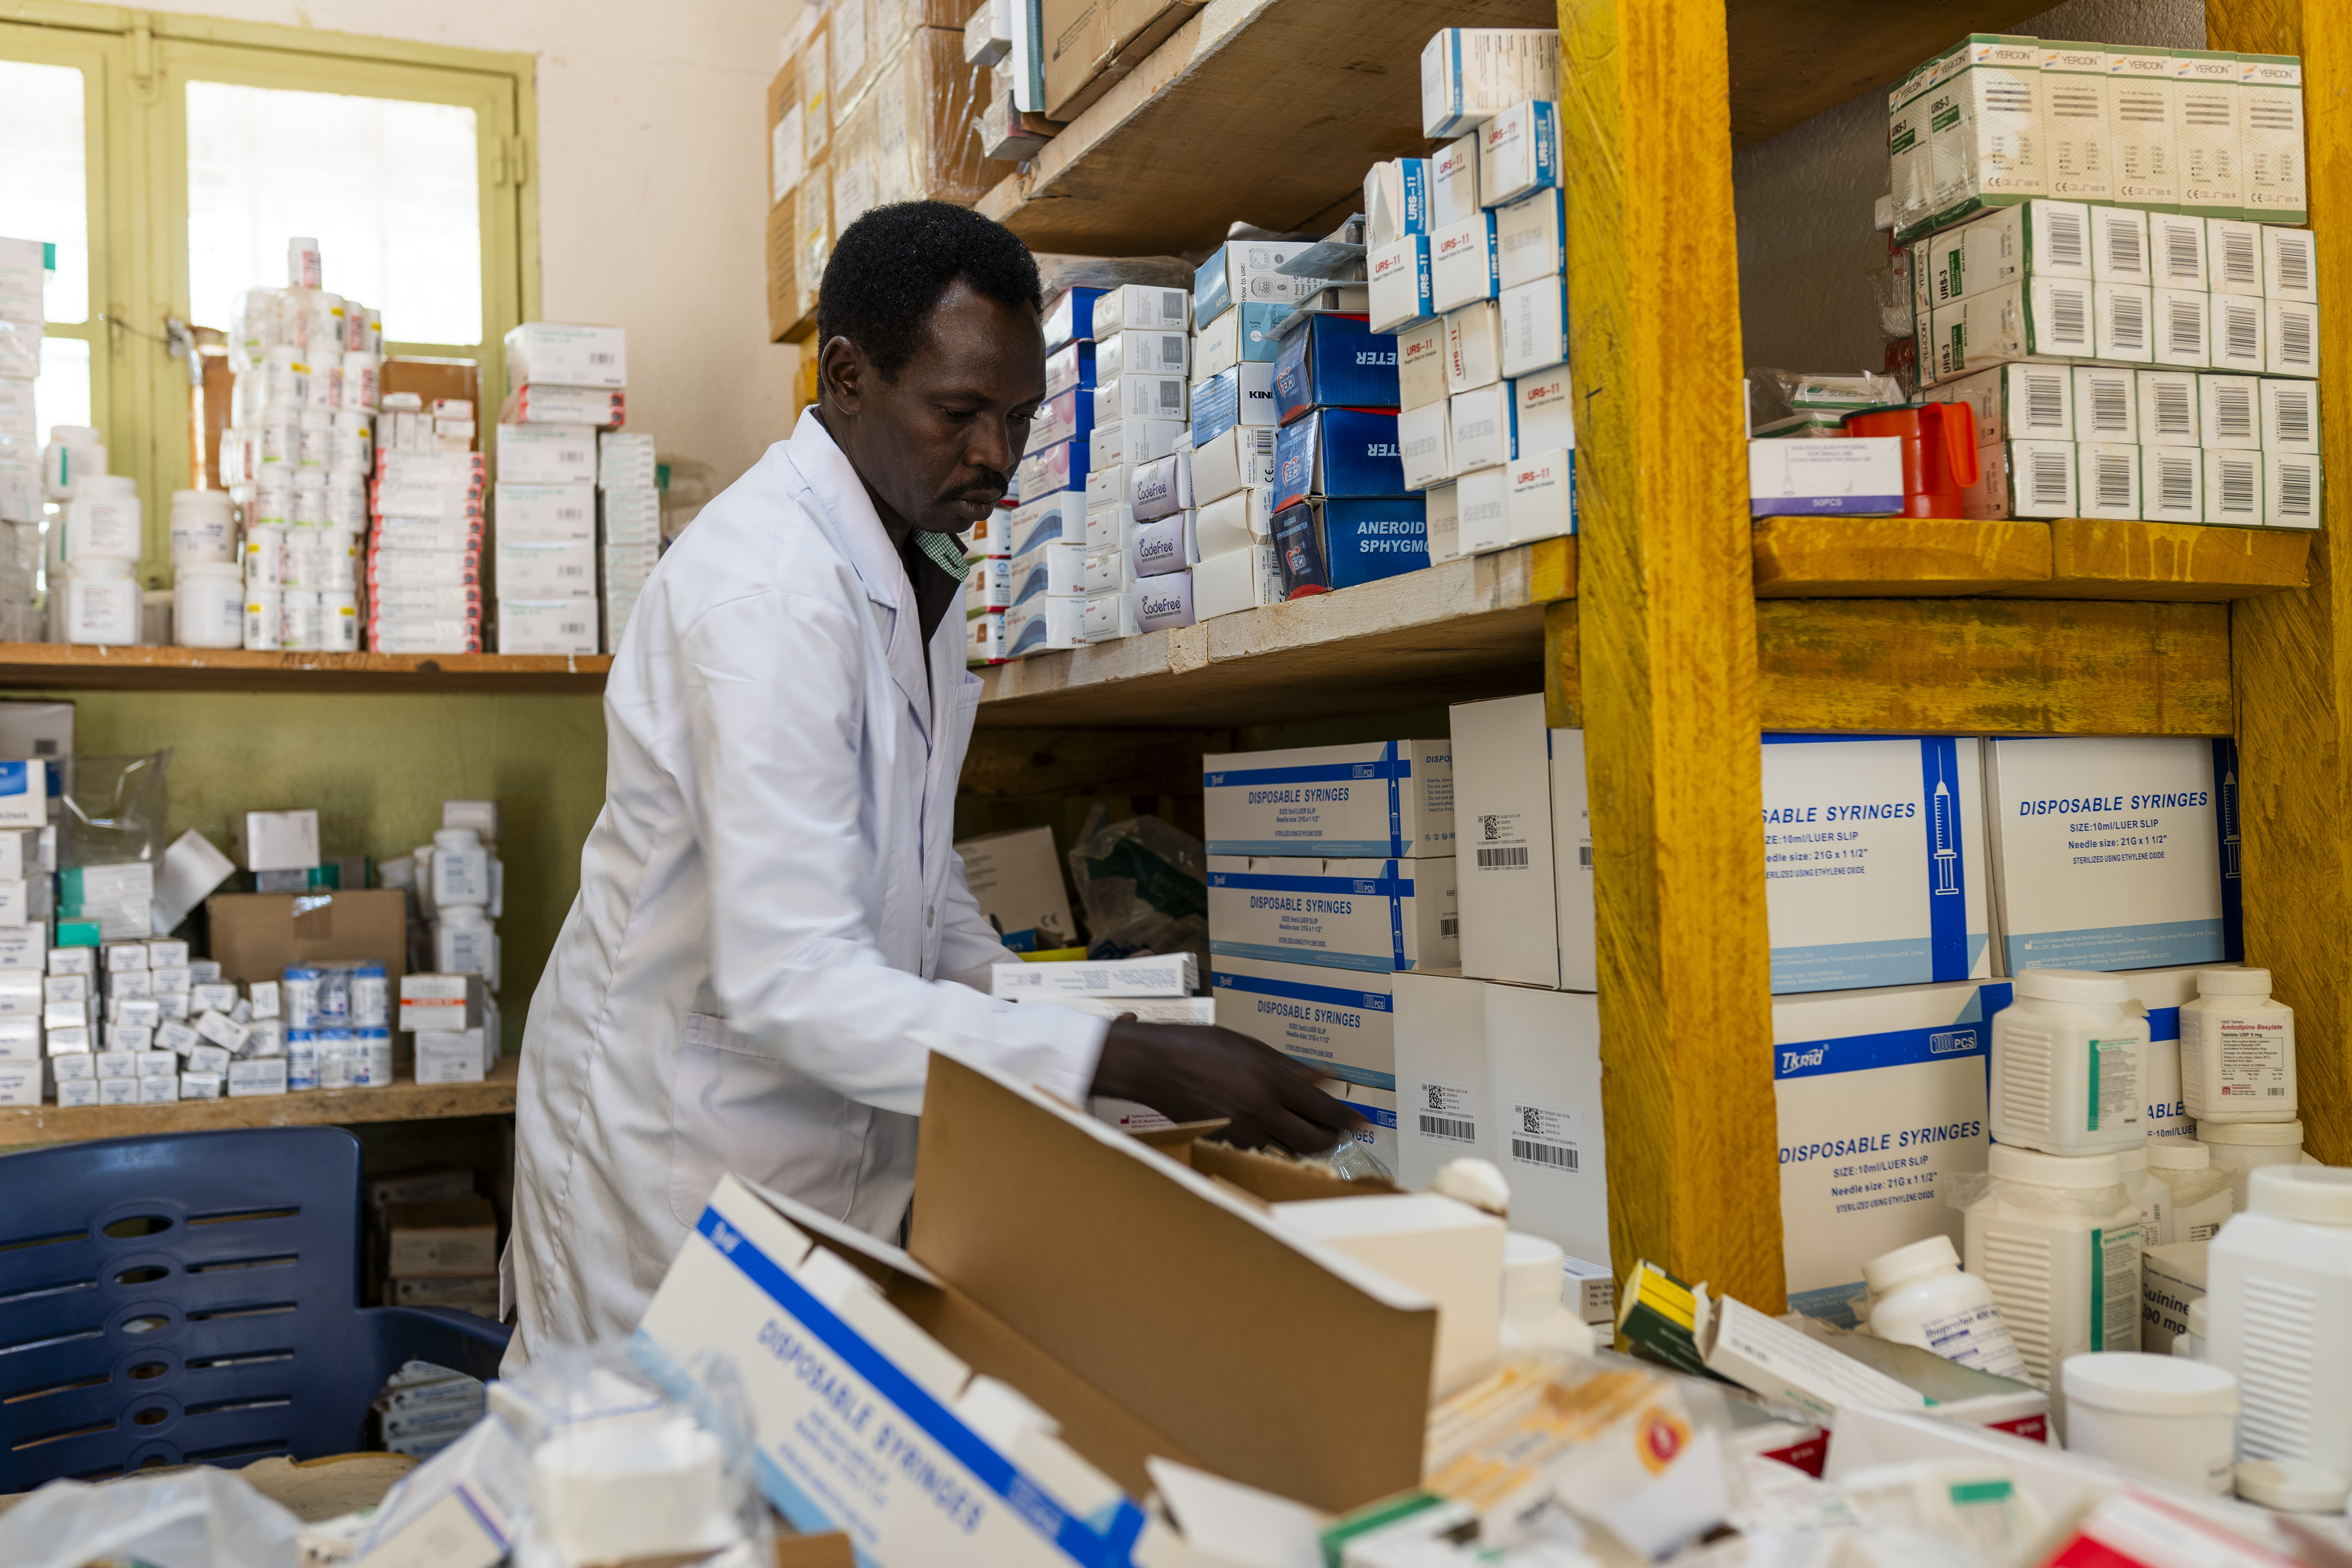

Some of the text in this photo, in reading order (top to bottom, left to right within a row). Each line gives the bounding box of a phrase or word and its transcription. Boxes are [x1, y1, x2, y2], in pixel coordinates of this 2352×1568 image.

[1994, 50, 2031, 60] YERCON
[2062, 56, 2098, 65] YERCON
[1941, 56, 1965, 74] YERCON
[2129, 60, 2164, 70] YERCON
[2194, 64, 2229, 74] YERCON
[2258, 69, 2293, 79] YERCON
[1931, 96, 1949, 114] URS-3
[1489, 122, 1517, 145] URS-11
[1892, 119, 1907, 137] URS-3
[1538, 119, 1549, 167] URS-11
[1440, 153, 1463, 175] URS-11
[1408, 176, 1418, 221] URS-11
[1441, 233, 1470, 252] URS-11
[1375, 254, 1400, 273] URS-11
[1420, 254, 1430, 298] URS-11
[1939, 270, 1948, 300] URS-3
[1216, 294, 1227, 308] SEJOY
[1406, 338, 1433, 356] URS-11
[1452, 330, 1462, 376] URS-11
[1356, 352, 1398, 365] ETER
[1528, 382, 1560, 400] URS-11
[1518, 468, 1550, 484] URS-11
[1138, 483, 1166, 500] CodeFree
[1284, 516, 1296, 527] ANEROID
[1357, 521, 1425, 535] ANEROID
[1277, 522, 1308, 540] SPHYGMOMANOMETER
[1140, 541, 1173, 557] CodeFree
[1143, 598, 1180, 614] CodeFree
[1249, 788, 1349, 804] DISPOSABLE SYRINGES
[2020, 791, 2208, 816] DISPOSABLE SYRINGES
[1827, 803, 1915, 821] SYRINGES
[2070, 819, 2159, 832] SIZE:10ml/LUER SLIP
[1837, 832, 1859, 841] SLIP
[2068, 839, 2097, 850] Needle
[2099, 838, 2119, 848] size:
[2121, 837, 2137, 847] 21G
[2152, 835, 2167, 844] 1/2"
[1789, 852, 1812, 861] size:
[1814, 851, 1832, 860] 21G
[2074, 854, 2103, 865] STERILIZED
[2105, 854, 2121, 863] USING
[2122, 852, 2148, 861] ETHYLENE
[1796, 868, 1813, 877] USING
[1815, 868, 1846, 876] ETHYLENE
[1848, 866, 1865, 875] OXIDE
[1251, 896, 1351, 915] DISPOSABLE SYRINGES
[1258, 1001, 1360, 1028] DISPOSABLE SYRINGES
[1779, 1120, 1980, 1164] DISPOSABLE SYRINGES
[1833, 1155, 1929, 1178] SIZE:10ml/LUER SLIP
[1831, 1177, 1905, 1197] Needle size: 21G
[1836, 1190, 1935, 1214] STERILIZED USING ETHYLENE OXIDE
[1926, 1310, 1991, 1338] Ibuprofen 400
[755, 1316, 987, 1536] DISPOSABLE SYRINGES
